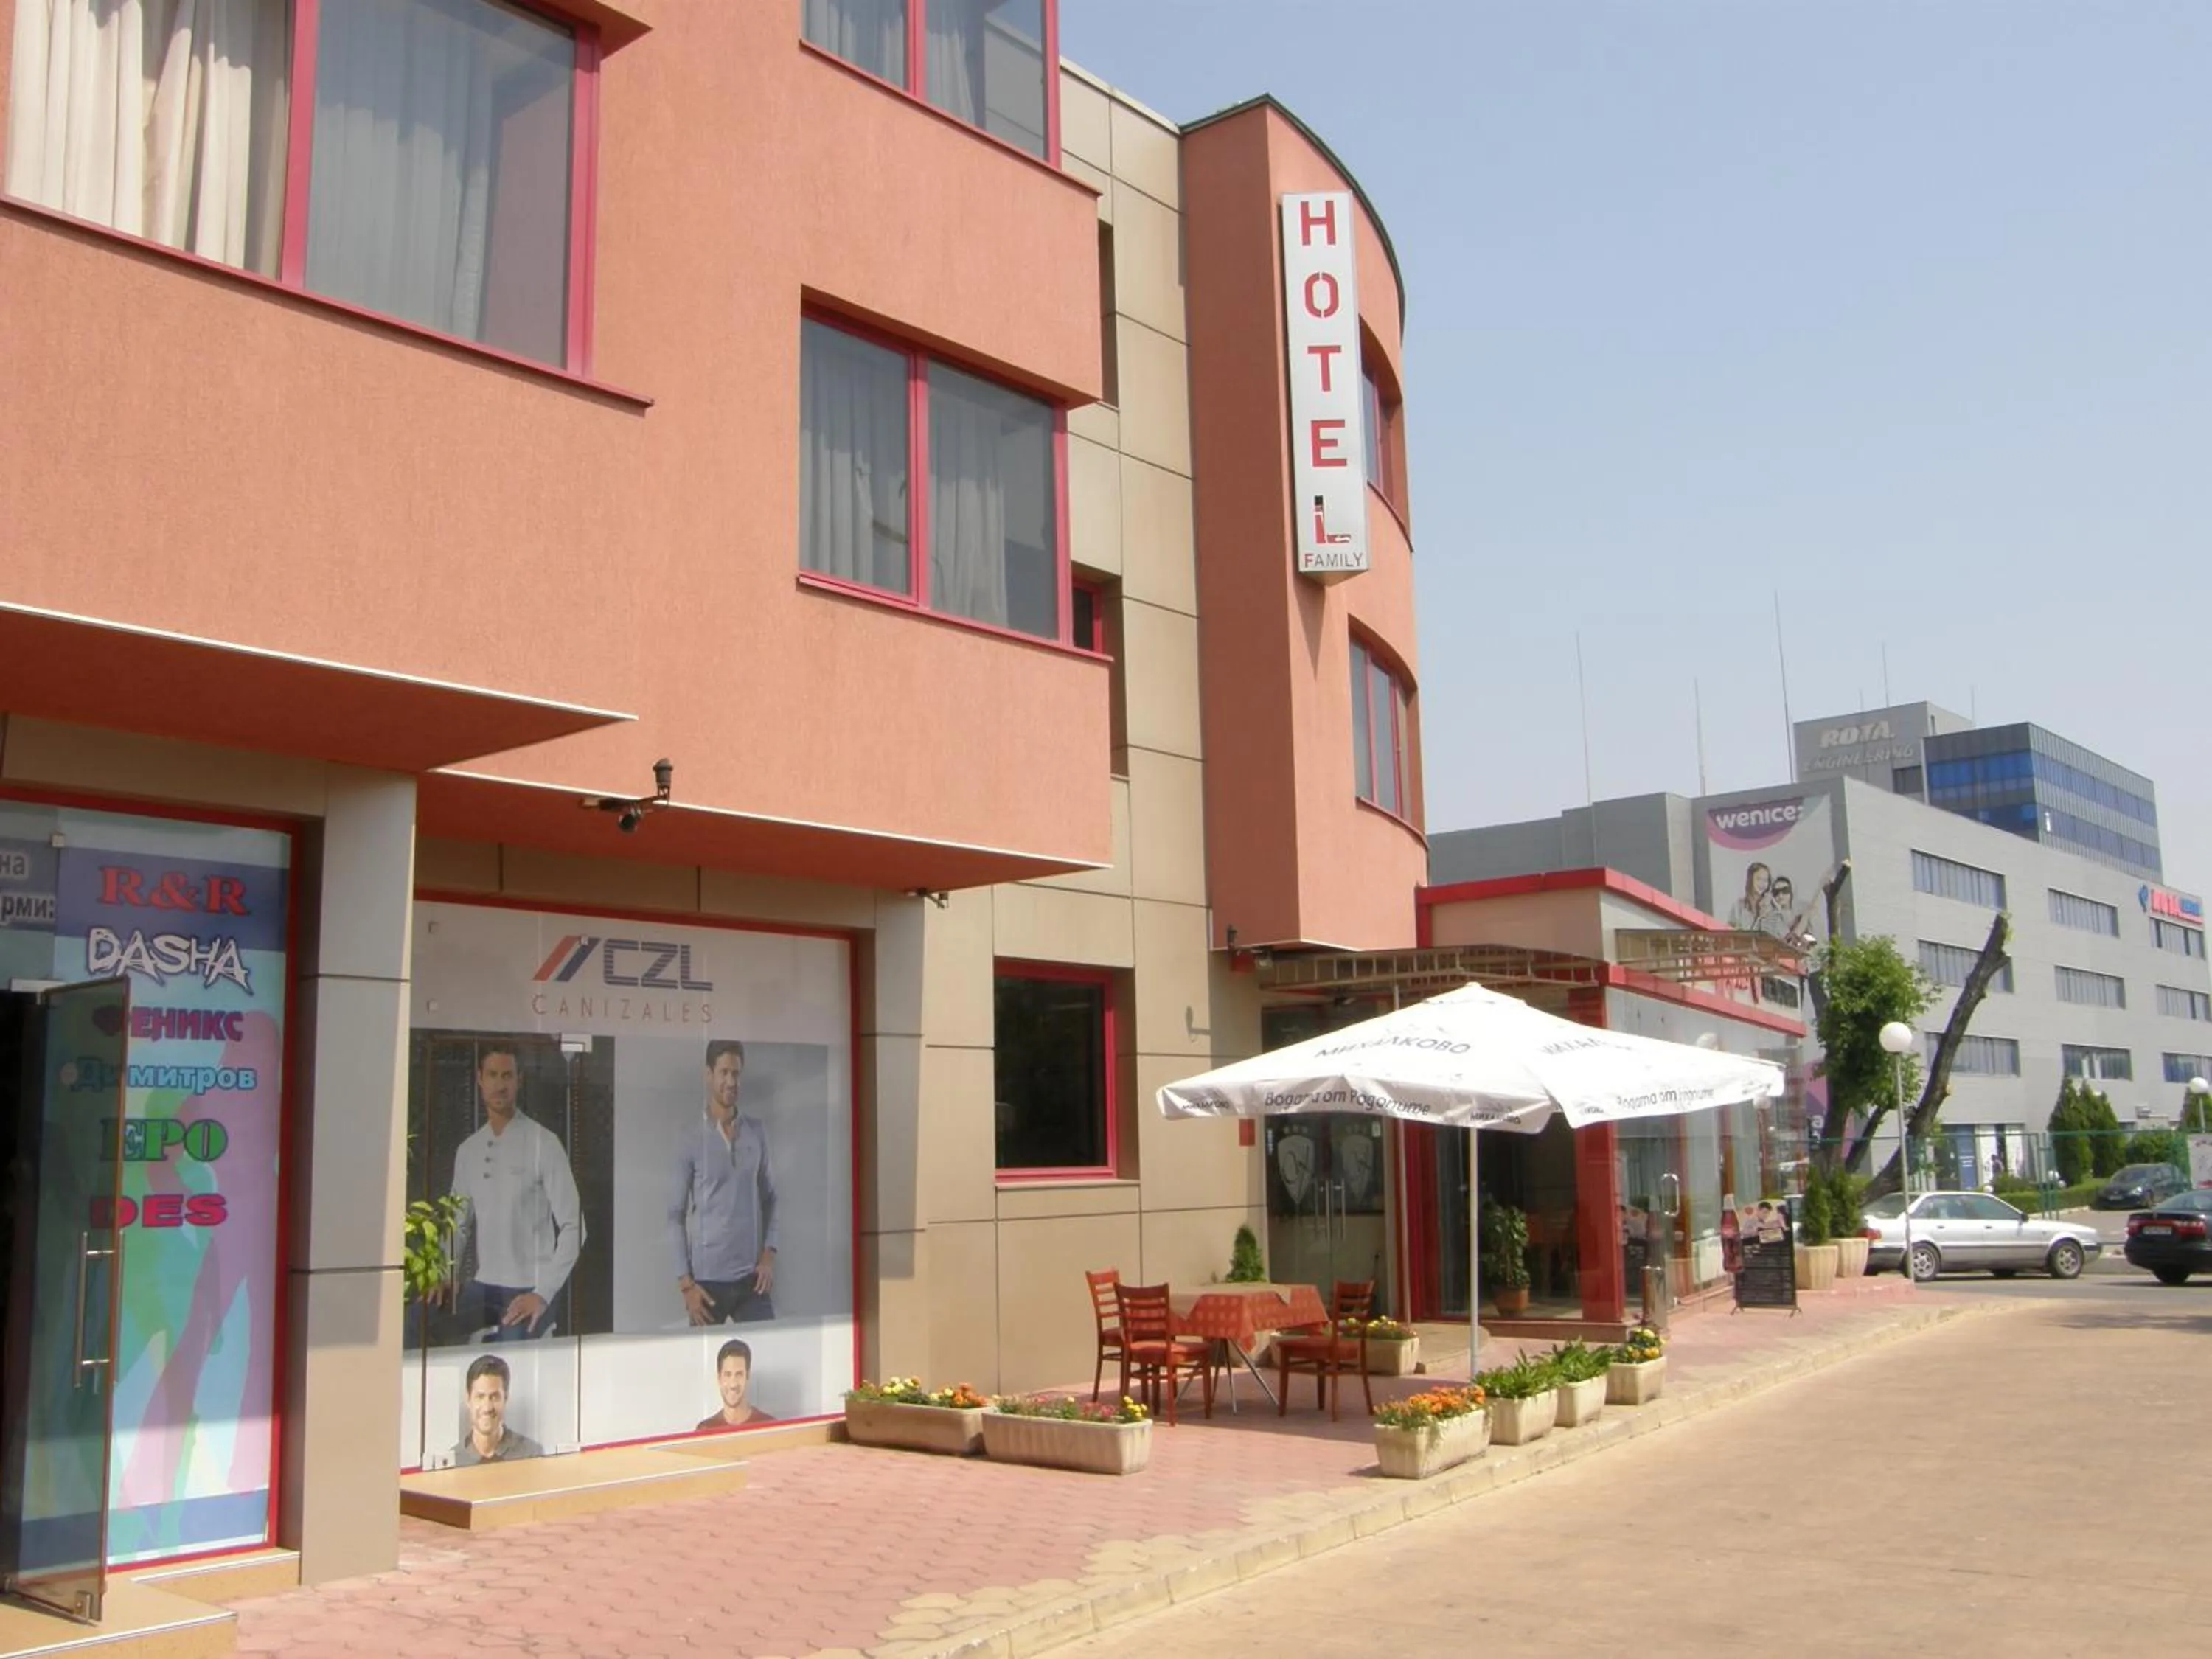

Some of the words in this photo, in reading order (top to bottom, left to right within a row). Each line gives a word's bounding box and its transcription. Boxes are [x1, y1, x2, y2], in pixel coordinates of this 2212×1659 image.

[1299, 200, 1352, 544] HOTEL
[1304, 552, 1364, 569] FAMILY
[96, 865, 251, 917] R&R
[86, 927, 255, 996] DASHA
[603, 939, 714, 992] CZL
[531, 995, 713, 1023] CANIZALES
[88, 1192, 229, 1230] DES
